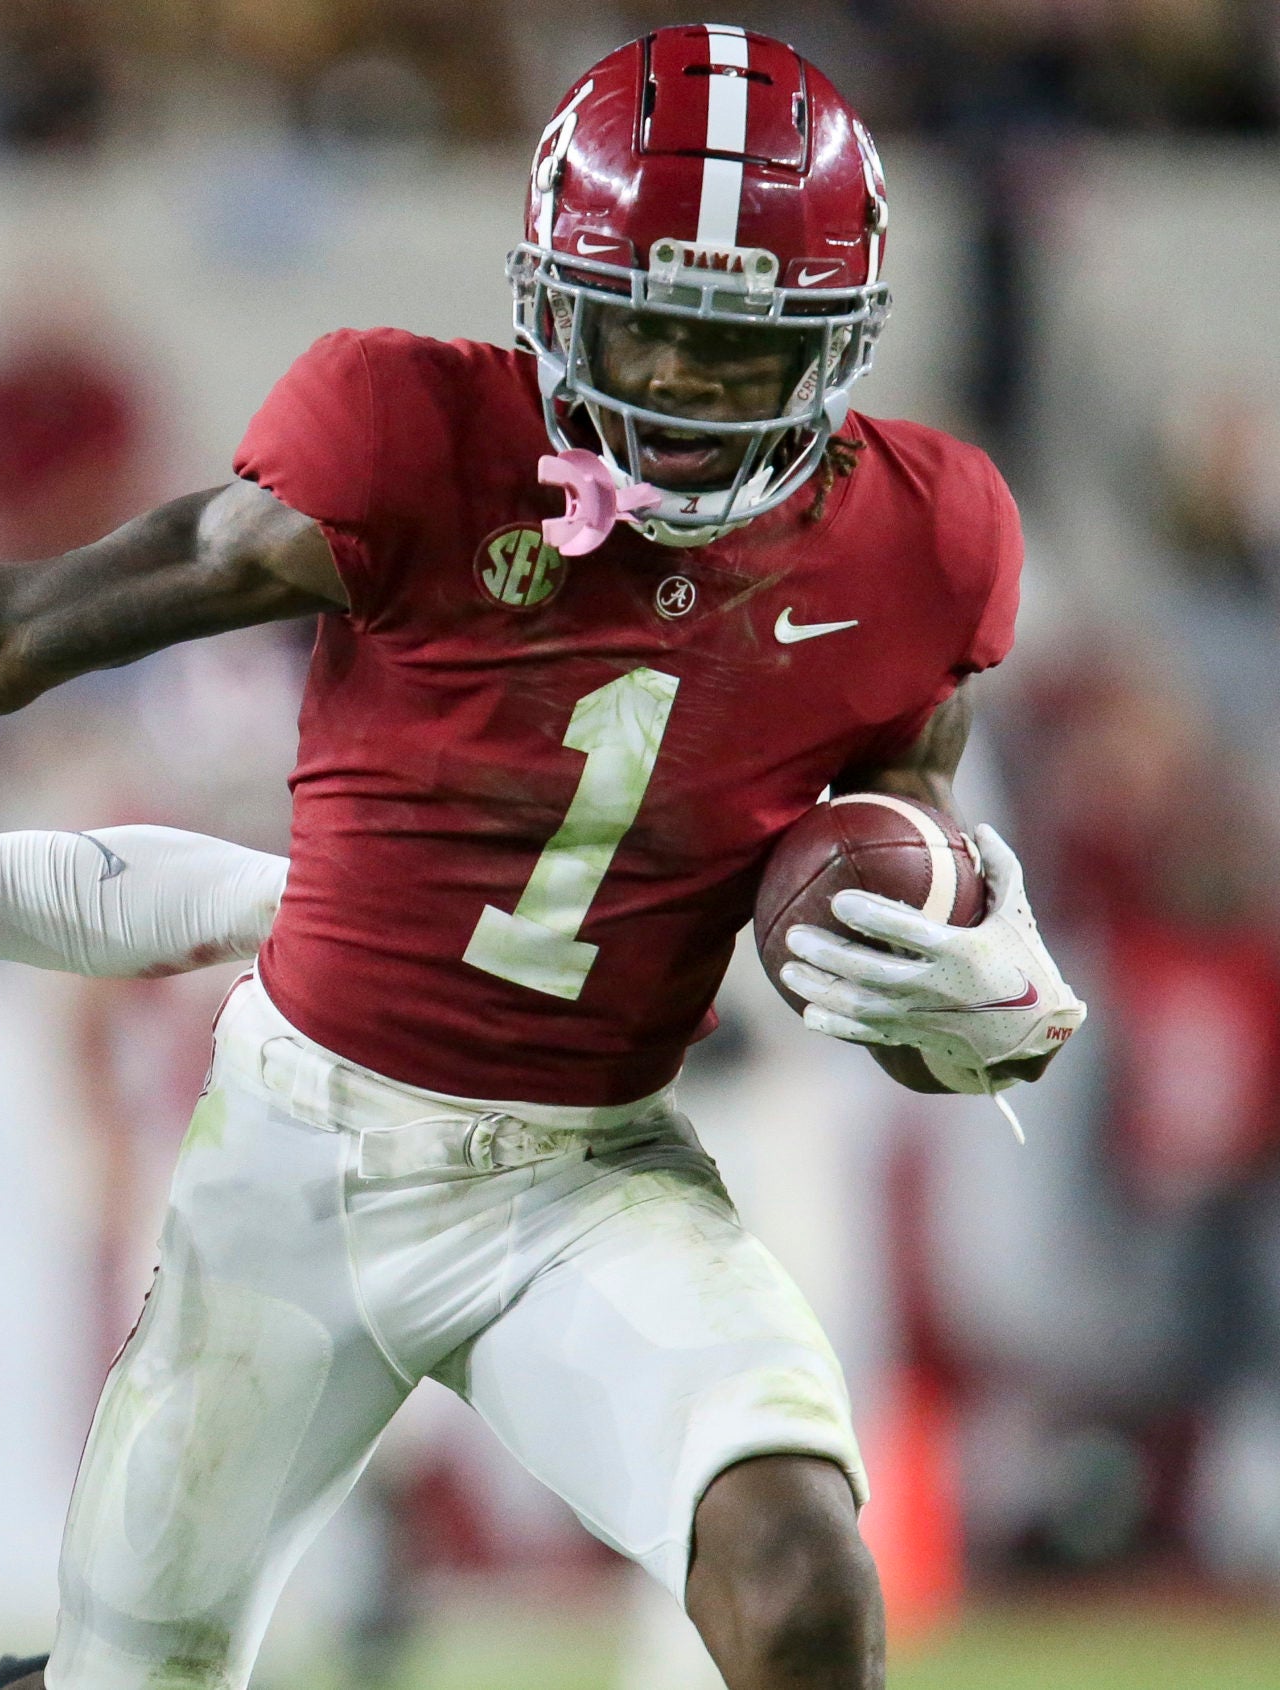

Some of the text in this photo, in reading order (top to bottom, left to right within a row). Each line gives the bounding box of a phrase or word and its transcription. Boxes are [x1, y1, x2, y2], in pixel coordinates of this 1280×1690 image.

[683, 249, 744, 274] BAMA
[482, 529, 562, 607] SEC
[462, 666, 681, 1001] 1
